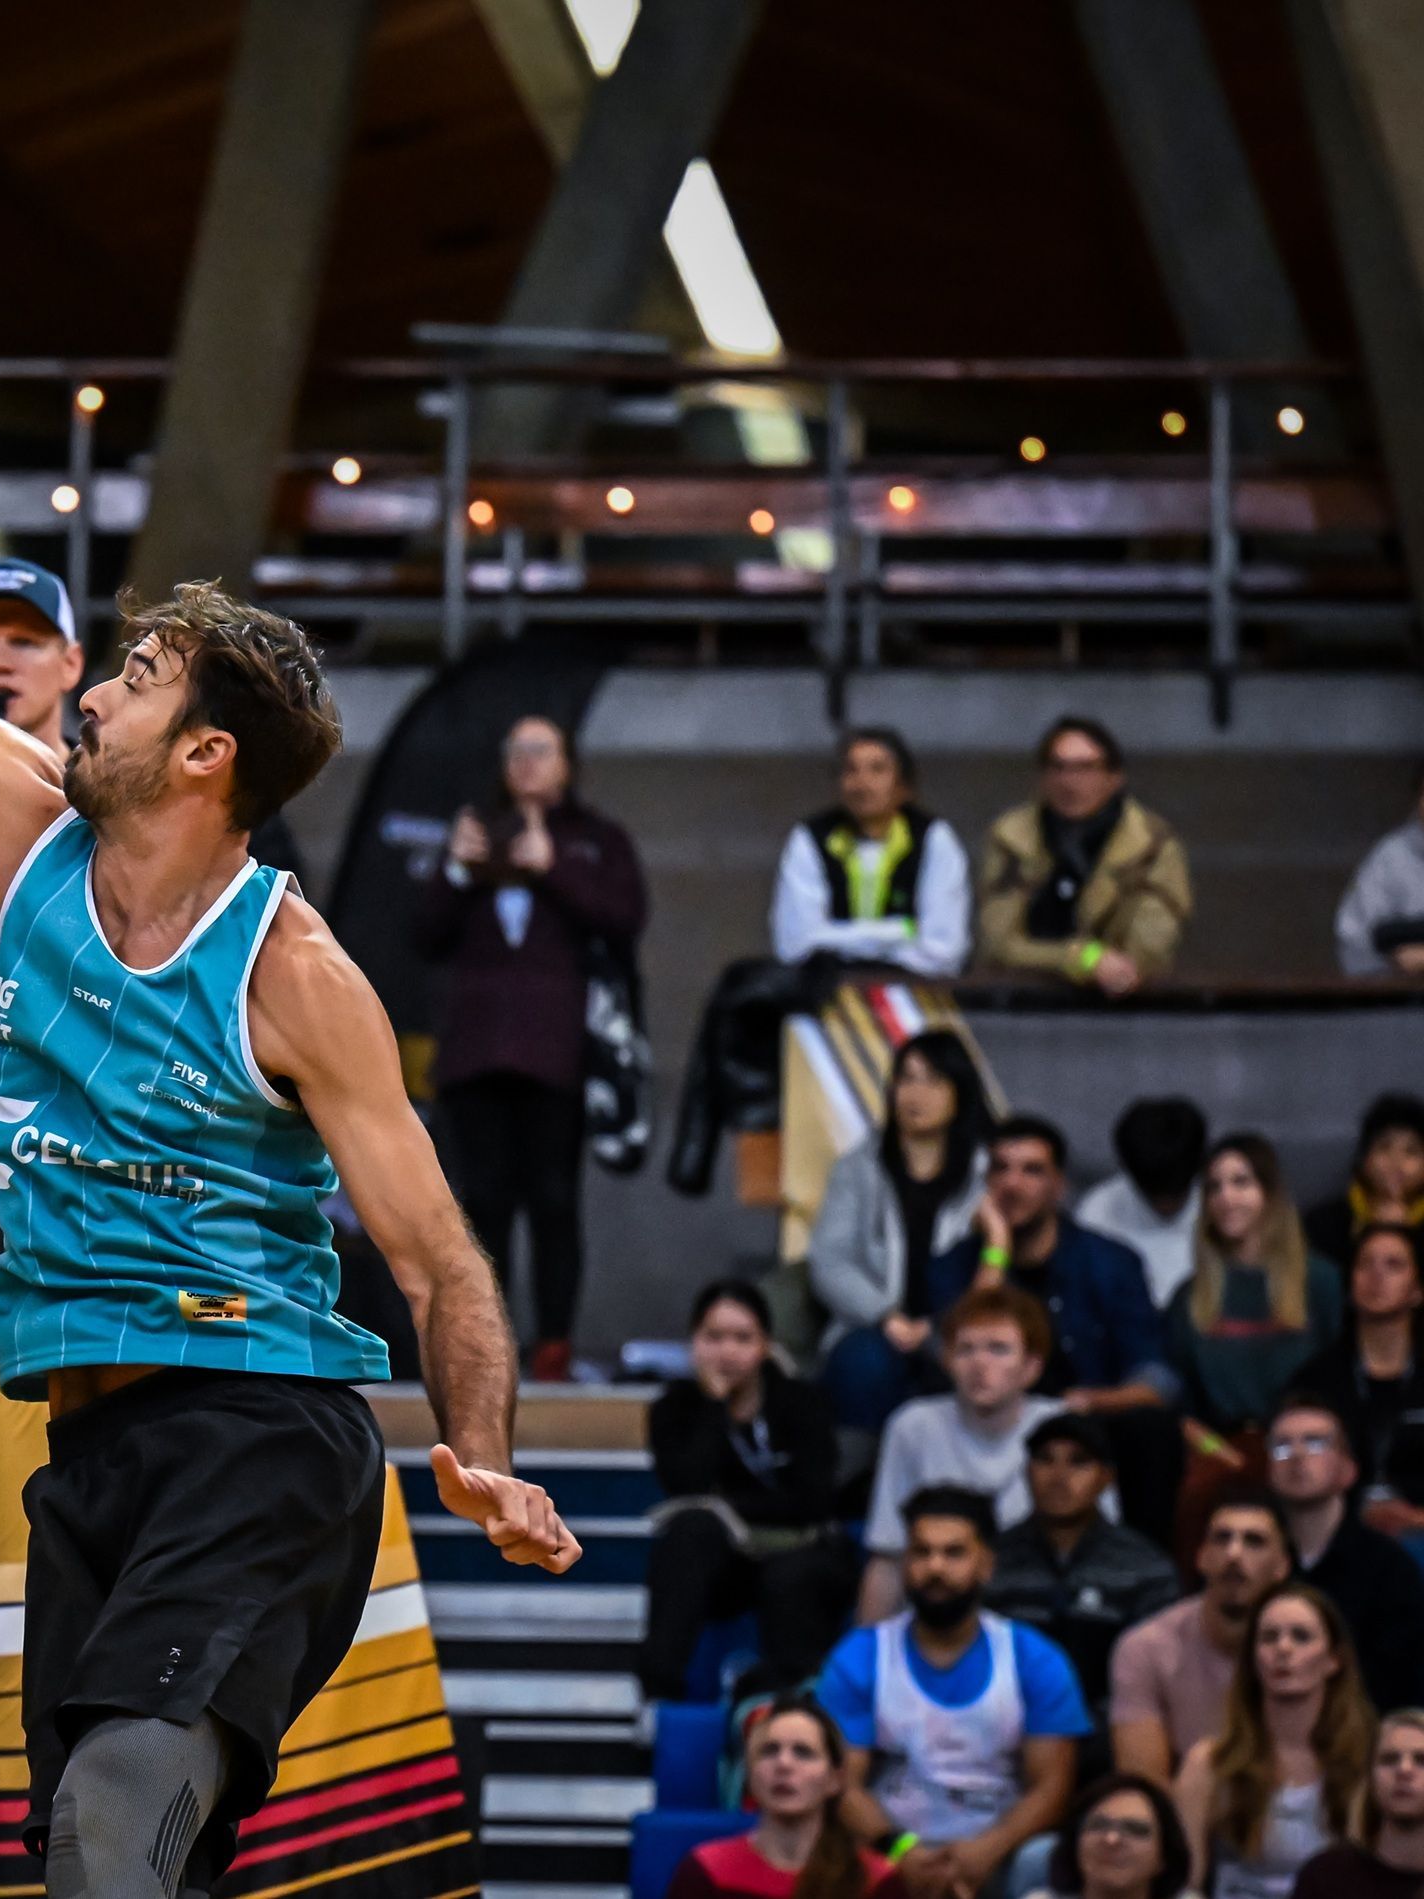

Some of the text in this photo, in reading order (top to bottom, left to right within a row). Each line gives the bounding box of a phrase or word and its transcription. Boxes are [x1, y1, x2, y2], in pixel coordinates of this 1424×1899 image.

[73, 987, 111, 1010] STAR
[172, 1061, 208, 1087] FIVB
[131, 1180, 204, 1206] LIVE FIT
